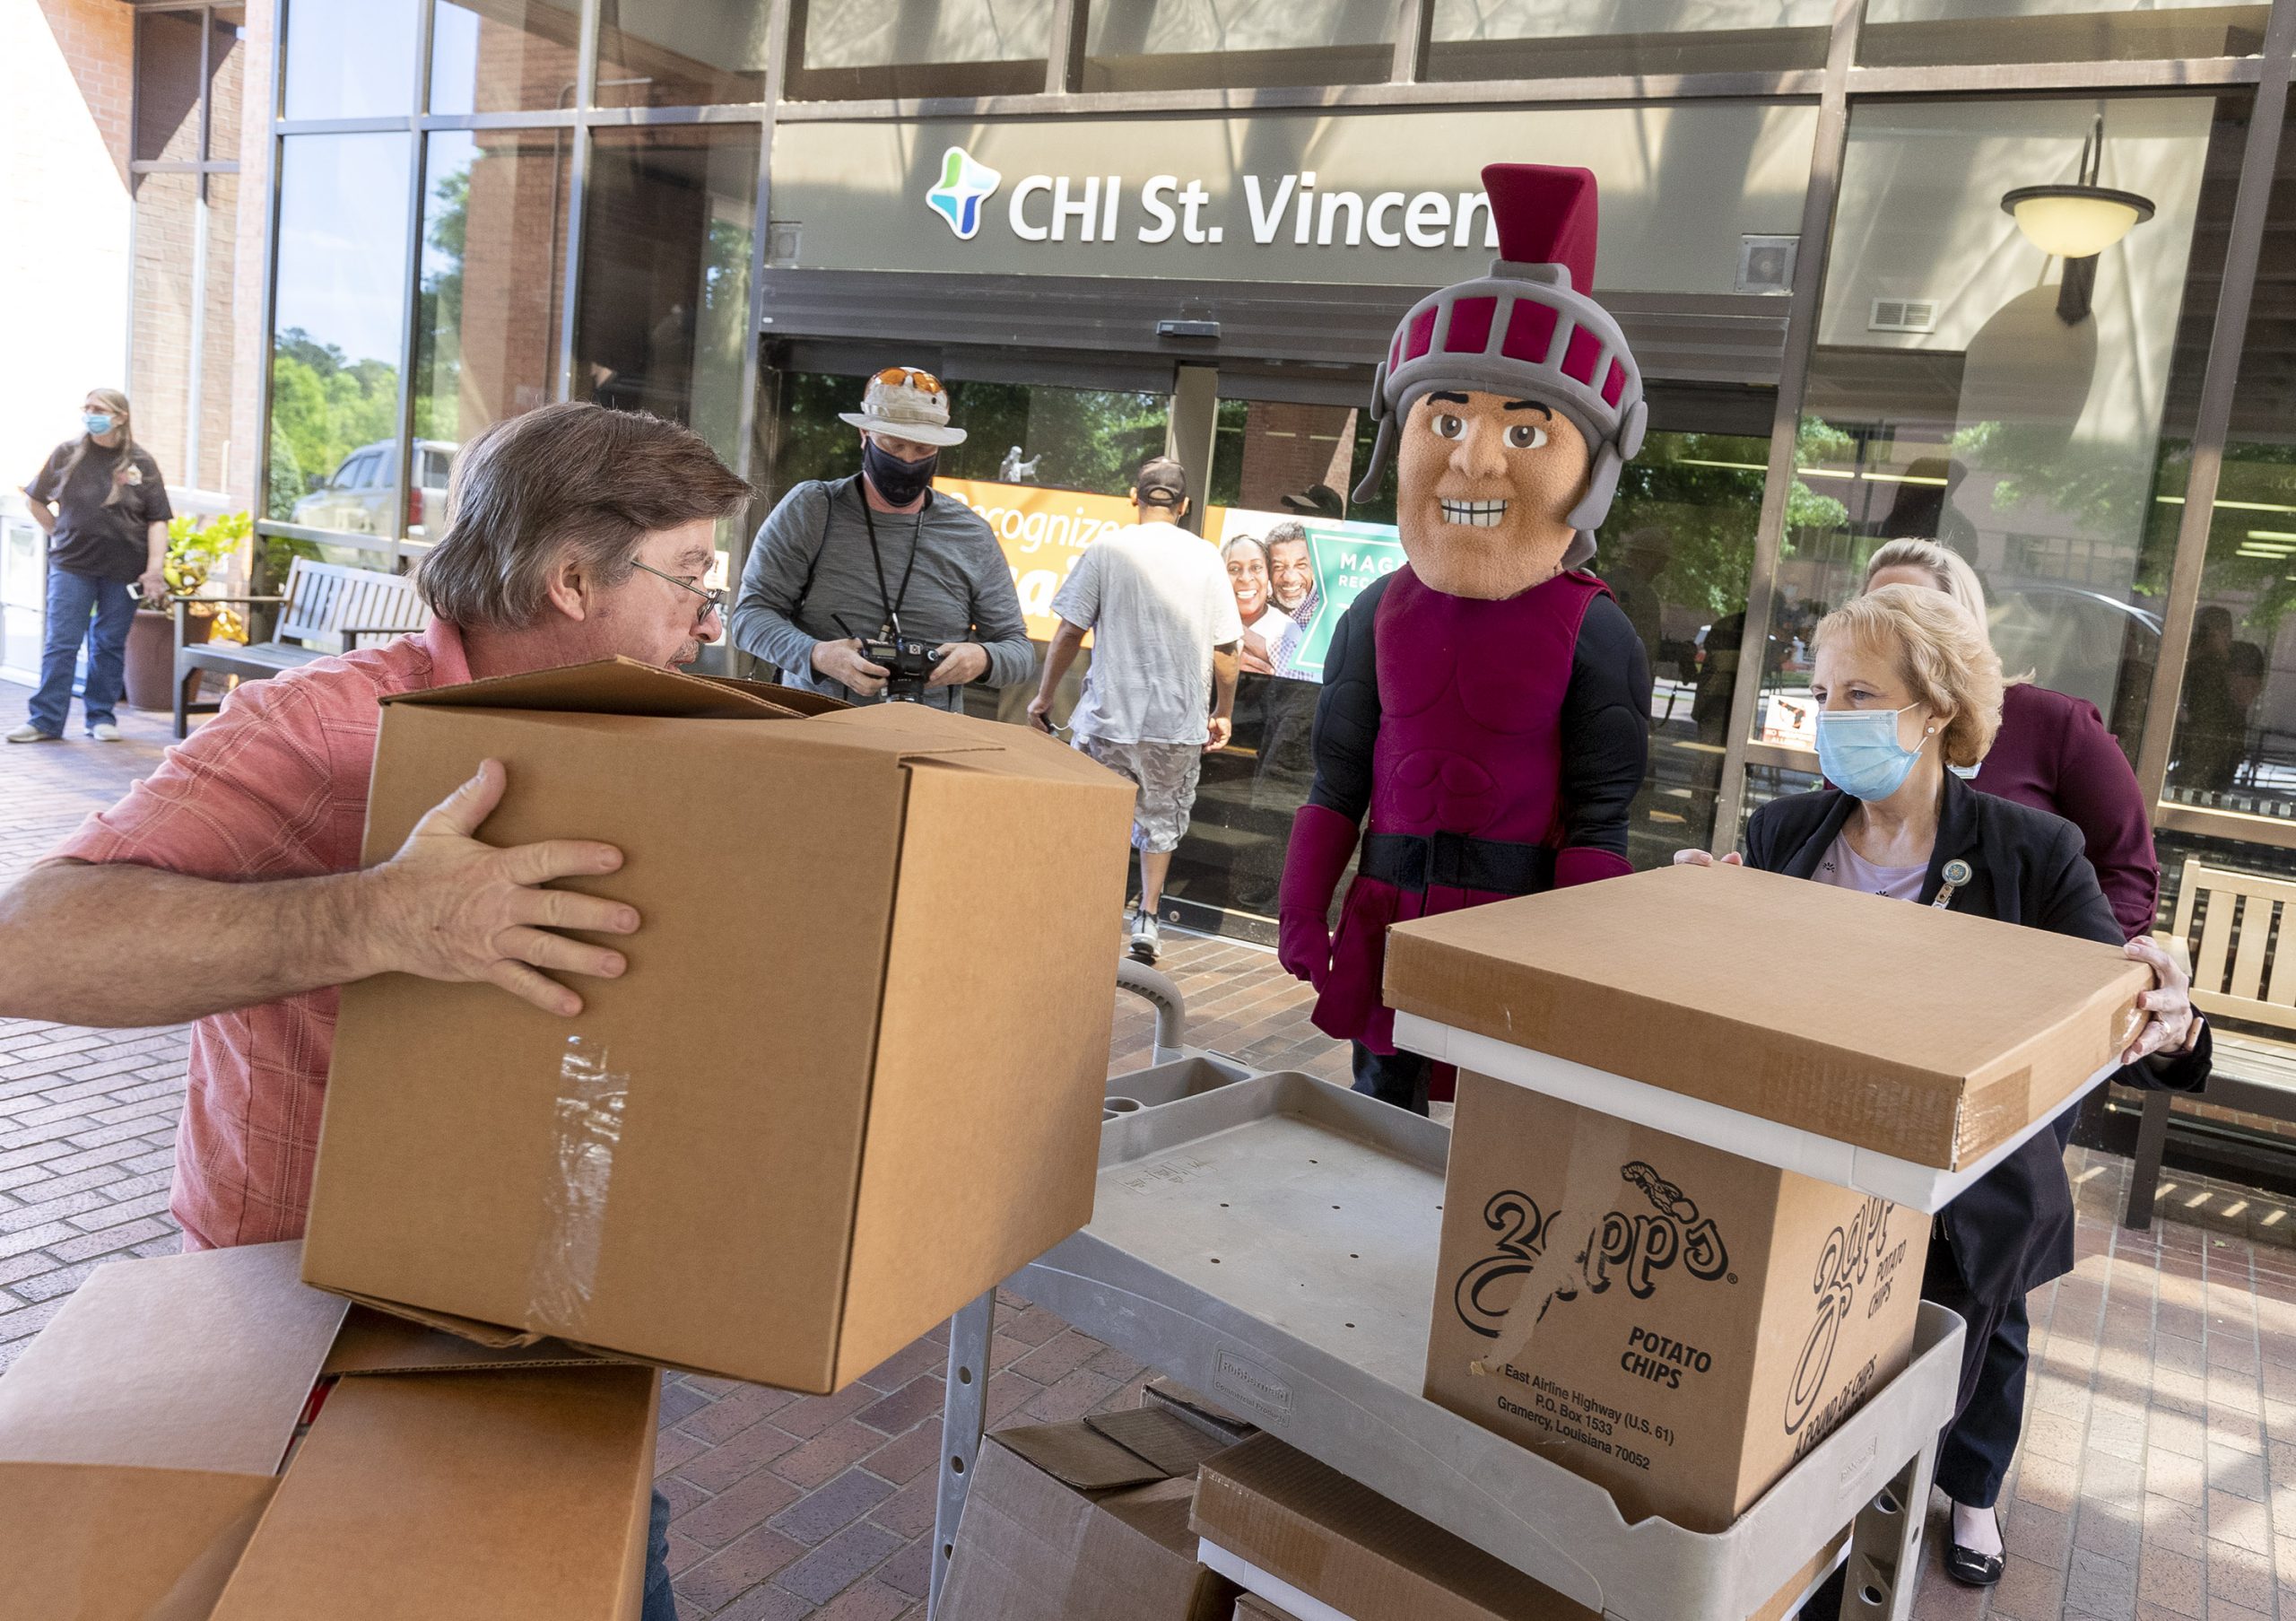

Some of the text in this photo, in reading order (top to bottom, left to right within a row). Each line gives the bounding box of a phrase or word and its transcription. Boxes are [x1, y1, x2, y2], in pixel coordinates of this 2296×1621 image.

[1009, 171, 1500, 248] CHI St. Vincen
[1338, 574, 1376, 589] REC
[1340, 553, 1406, 575] MAG
[1874, 1239, 1907, 1288] POTATO
[1867, 1276, 1893, 1320] CHIPS
[1621, 1351, 1683, 1390] CHIPS
[1628, 1326, 1711, 1373] POTATO
[1505, 1363, 1674, 1447] East Airline Highway (U.S. 61)
[1535, 1393, 1613, 1437] P.O. Box 1533
[1498, 1396, 1651, 1471] Gramercy, Louisiana 70052
